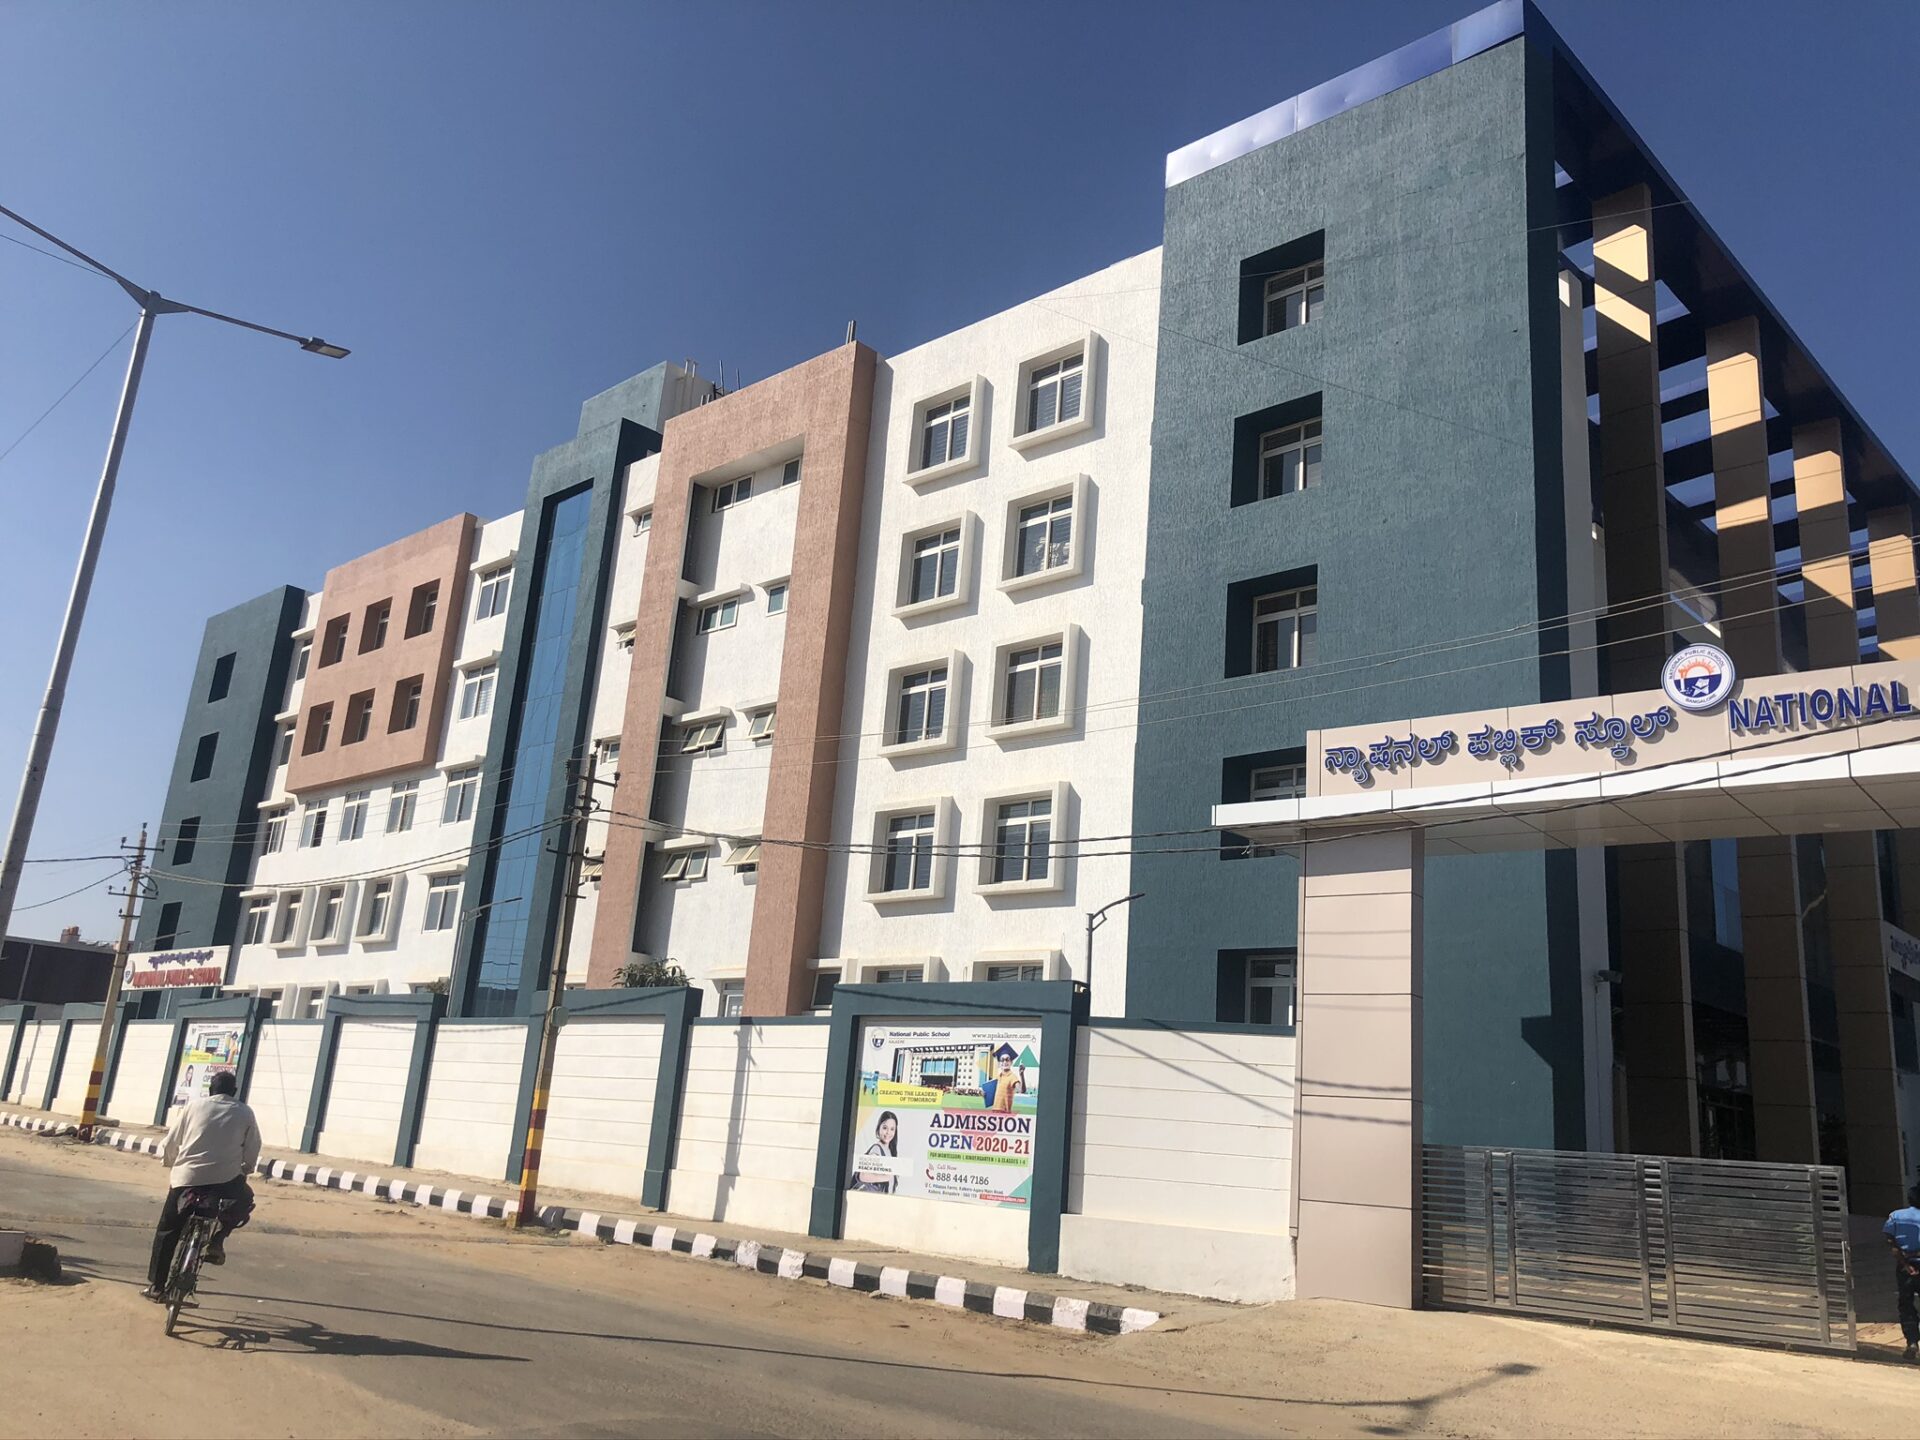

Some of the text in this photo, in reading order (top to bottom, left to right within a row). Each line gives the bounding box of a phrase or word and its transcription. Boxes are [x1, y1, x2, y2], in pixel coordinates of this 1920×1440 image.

[1706, 650, 1724, 666] SCHOOL
[1727, 680, 1912, 731] NATIONAL
[1324, 705, 1671, 783] ನ್ಯಾಷನಲ್ ಪಬ್ಲಿಕ್ ಸ್ಕೂಲ್
[930, 1113, 1031, 1133] ADMISSION
[928, 1133, 1029, 1154] OPEN 2020-21
[936, 1172, 989, 1185] 888 444 7186
